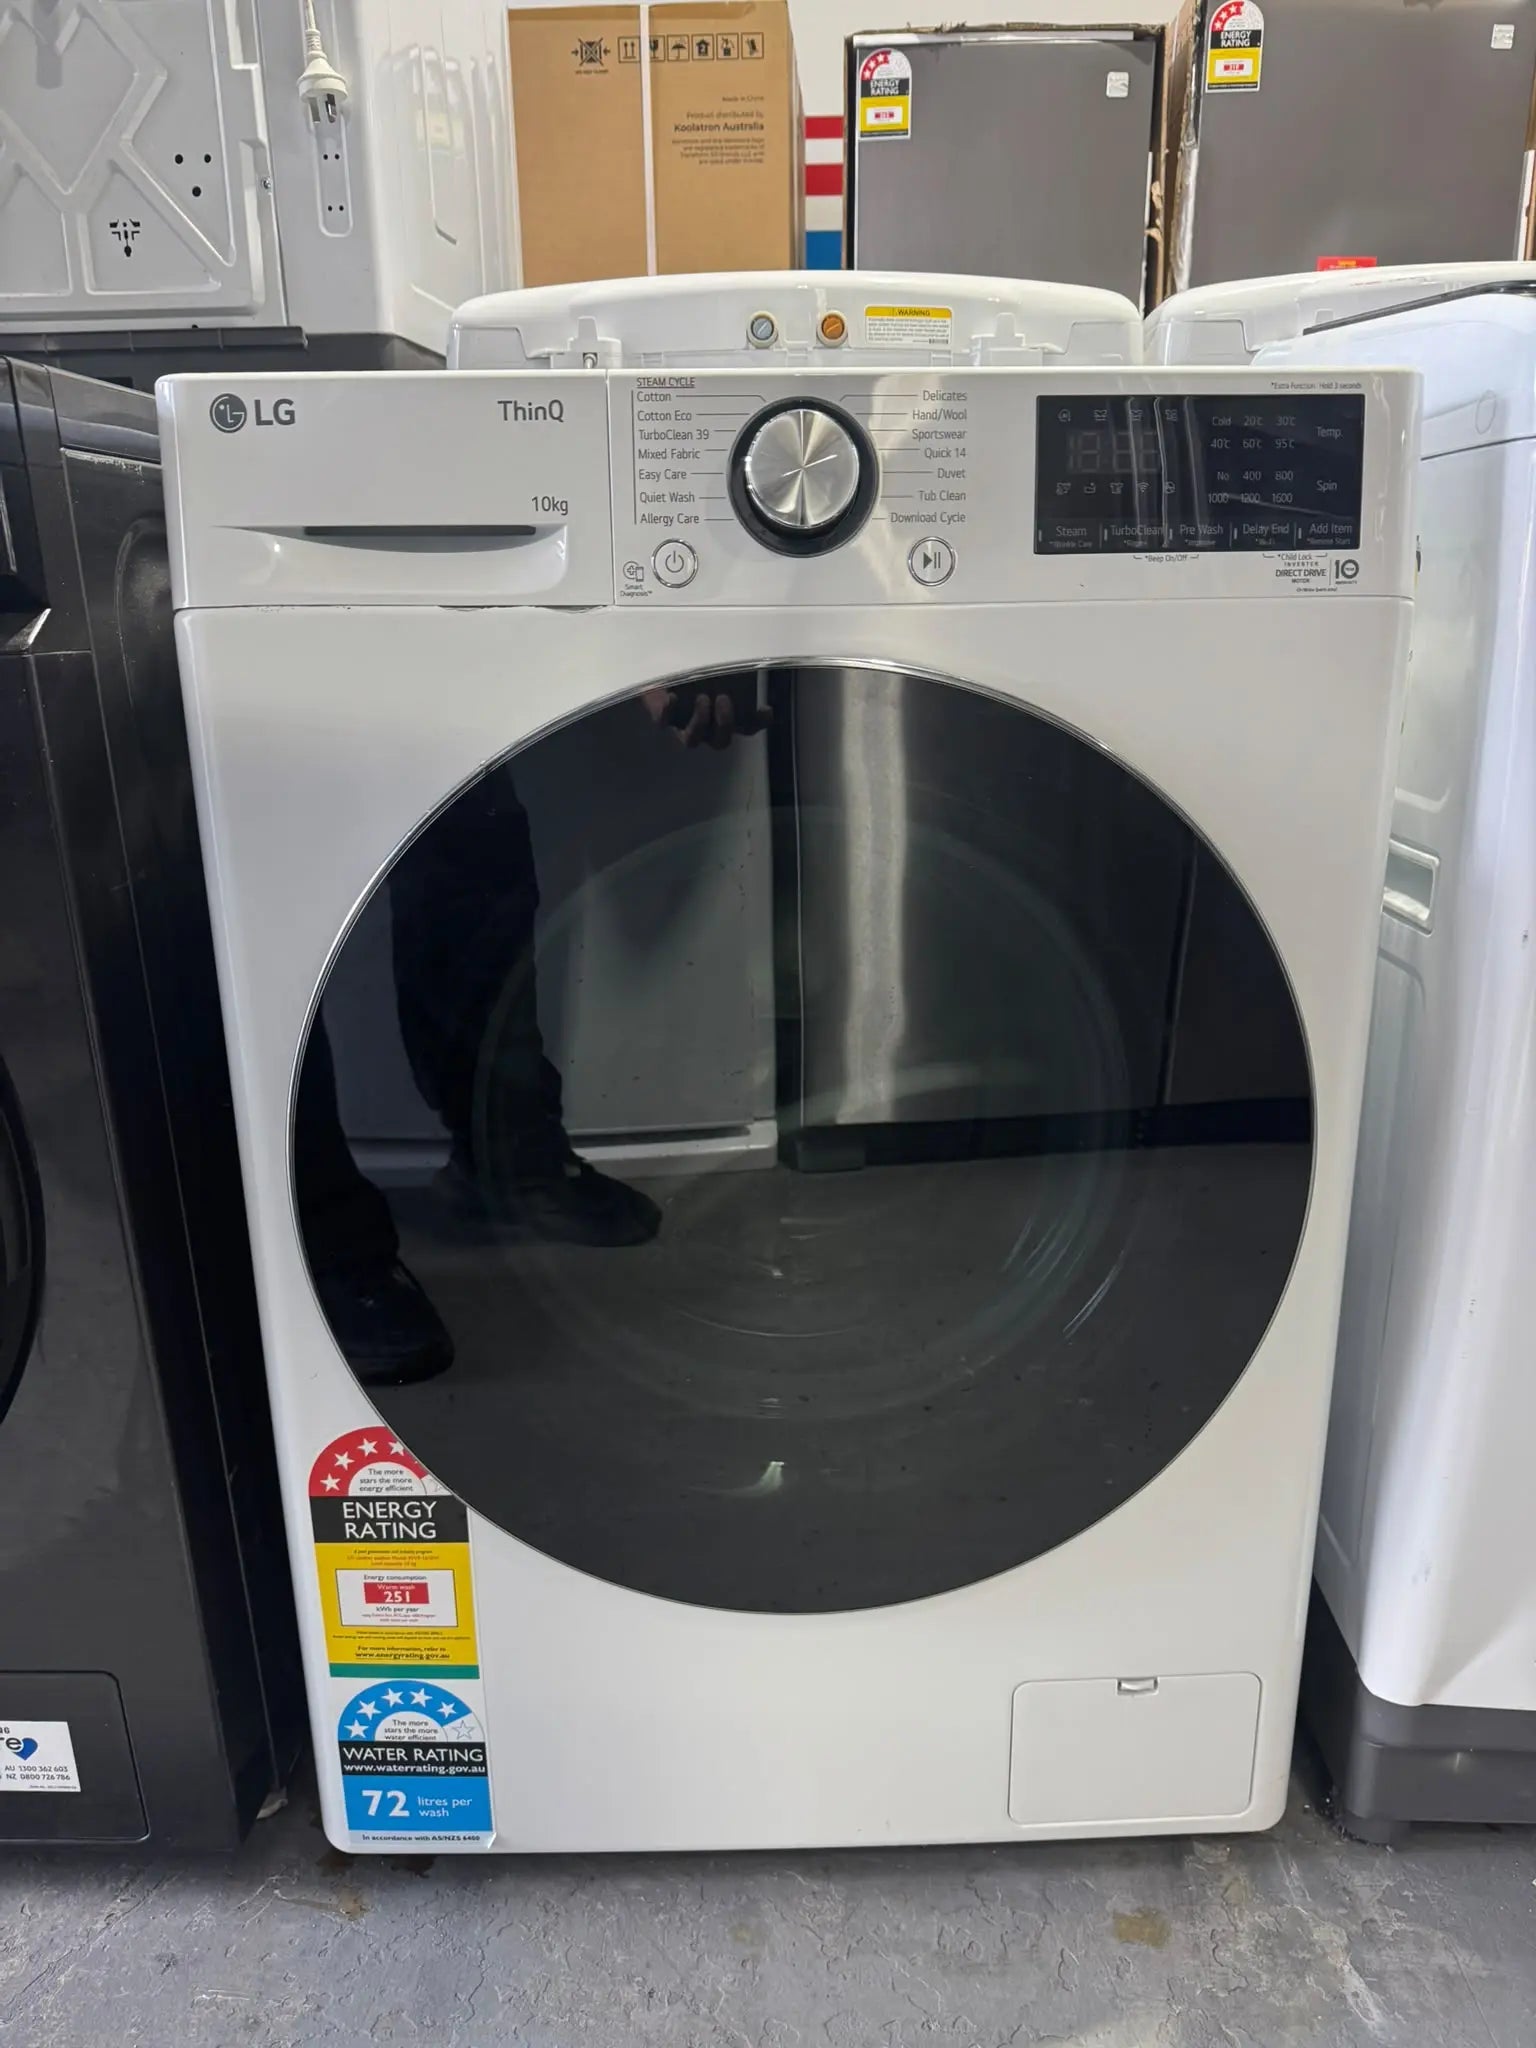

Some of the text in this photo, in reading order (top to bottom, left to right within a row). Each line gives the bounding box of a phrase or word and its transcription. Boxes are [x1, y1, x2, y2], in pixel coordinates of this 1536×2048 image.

[1220, 31, 1251, 39] ENERGY
[871, 88, 899, 96] RATING
[674, 122, 764, 132] Koolatron Australia
[637, 377, 695, 387] STEAM CYCLE
[637, 391, 672, 402] Cotton
[922, 390, 968, 400] Delicates
[254, 399, 296, 426] LG
[497, 400, 564, 422] ThinQ
[638, 410, 692, 421] Cotton Eco
[912, 409, 968, 420] Hand/Wool
[1212, 416, 1232, 426] Cold
[639, 429, 709, 440] TurboClean 39
[912, 428, 968, 442] Sportswear
[638, 448, 700, 460] Mixed Fabric
[924, 448, 966, 459] Quick 14
[639, 469, 687, 482] Easy Care
[938, 468, 966, 478] Duvet
[1217, 472, 1229, 480] No
[1242, 471, 1262, 480] 400
[1275, 471, 1294, 480] 800
[1316, 480, 1338, 493] Spin
[640, 492, 695, 503] Quiet Wash
[918, 490, 966, 500] Tub Clean
[1208, 494, 1229, 504] 1000
[1272, 494, 1293, 504] 1600
[532, 496, 569, 516] 10kg
[640, 513, 700, 526] Allergy Care
[890, 512, 966, 525] Download Cycle
[1056, 526, 1087, 536] Steam
[1110, 525, 1163, 536] TurboClean
[1180, 524, 1223, 534] Pre Wash
[1243, 524, 1289, 535] Delay End
[1310, 524, 1352, 534] Add Item
[1276, 570, 1302, 578] DIRECT
[1335, 559, 1360, 579] 10
[342, 1502, 437, 1519] ENERGY
[345, 1522, 436, 1539] RATING
[364, 1574, 384, 1582] Energy
[384, 1590, 410, 1603] 251
[356, 1652, 450, 1660] www.energyrating.gov.au
[344, 1748, 484, 1762] WATER RATING
[344, 1764, 486, 1774] www.waterrating.gov.au
[362, 1790, 472, 1817] 72 litres per
[418, 1808, 449, 1817] wash
